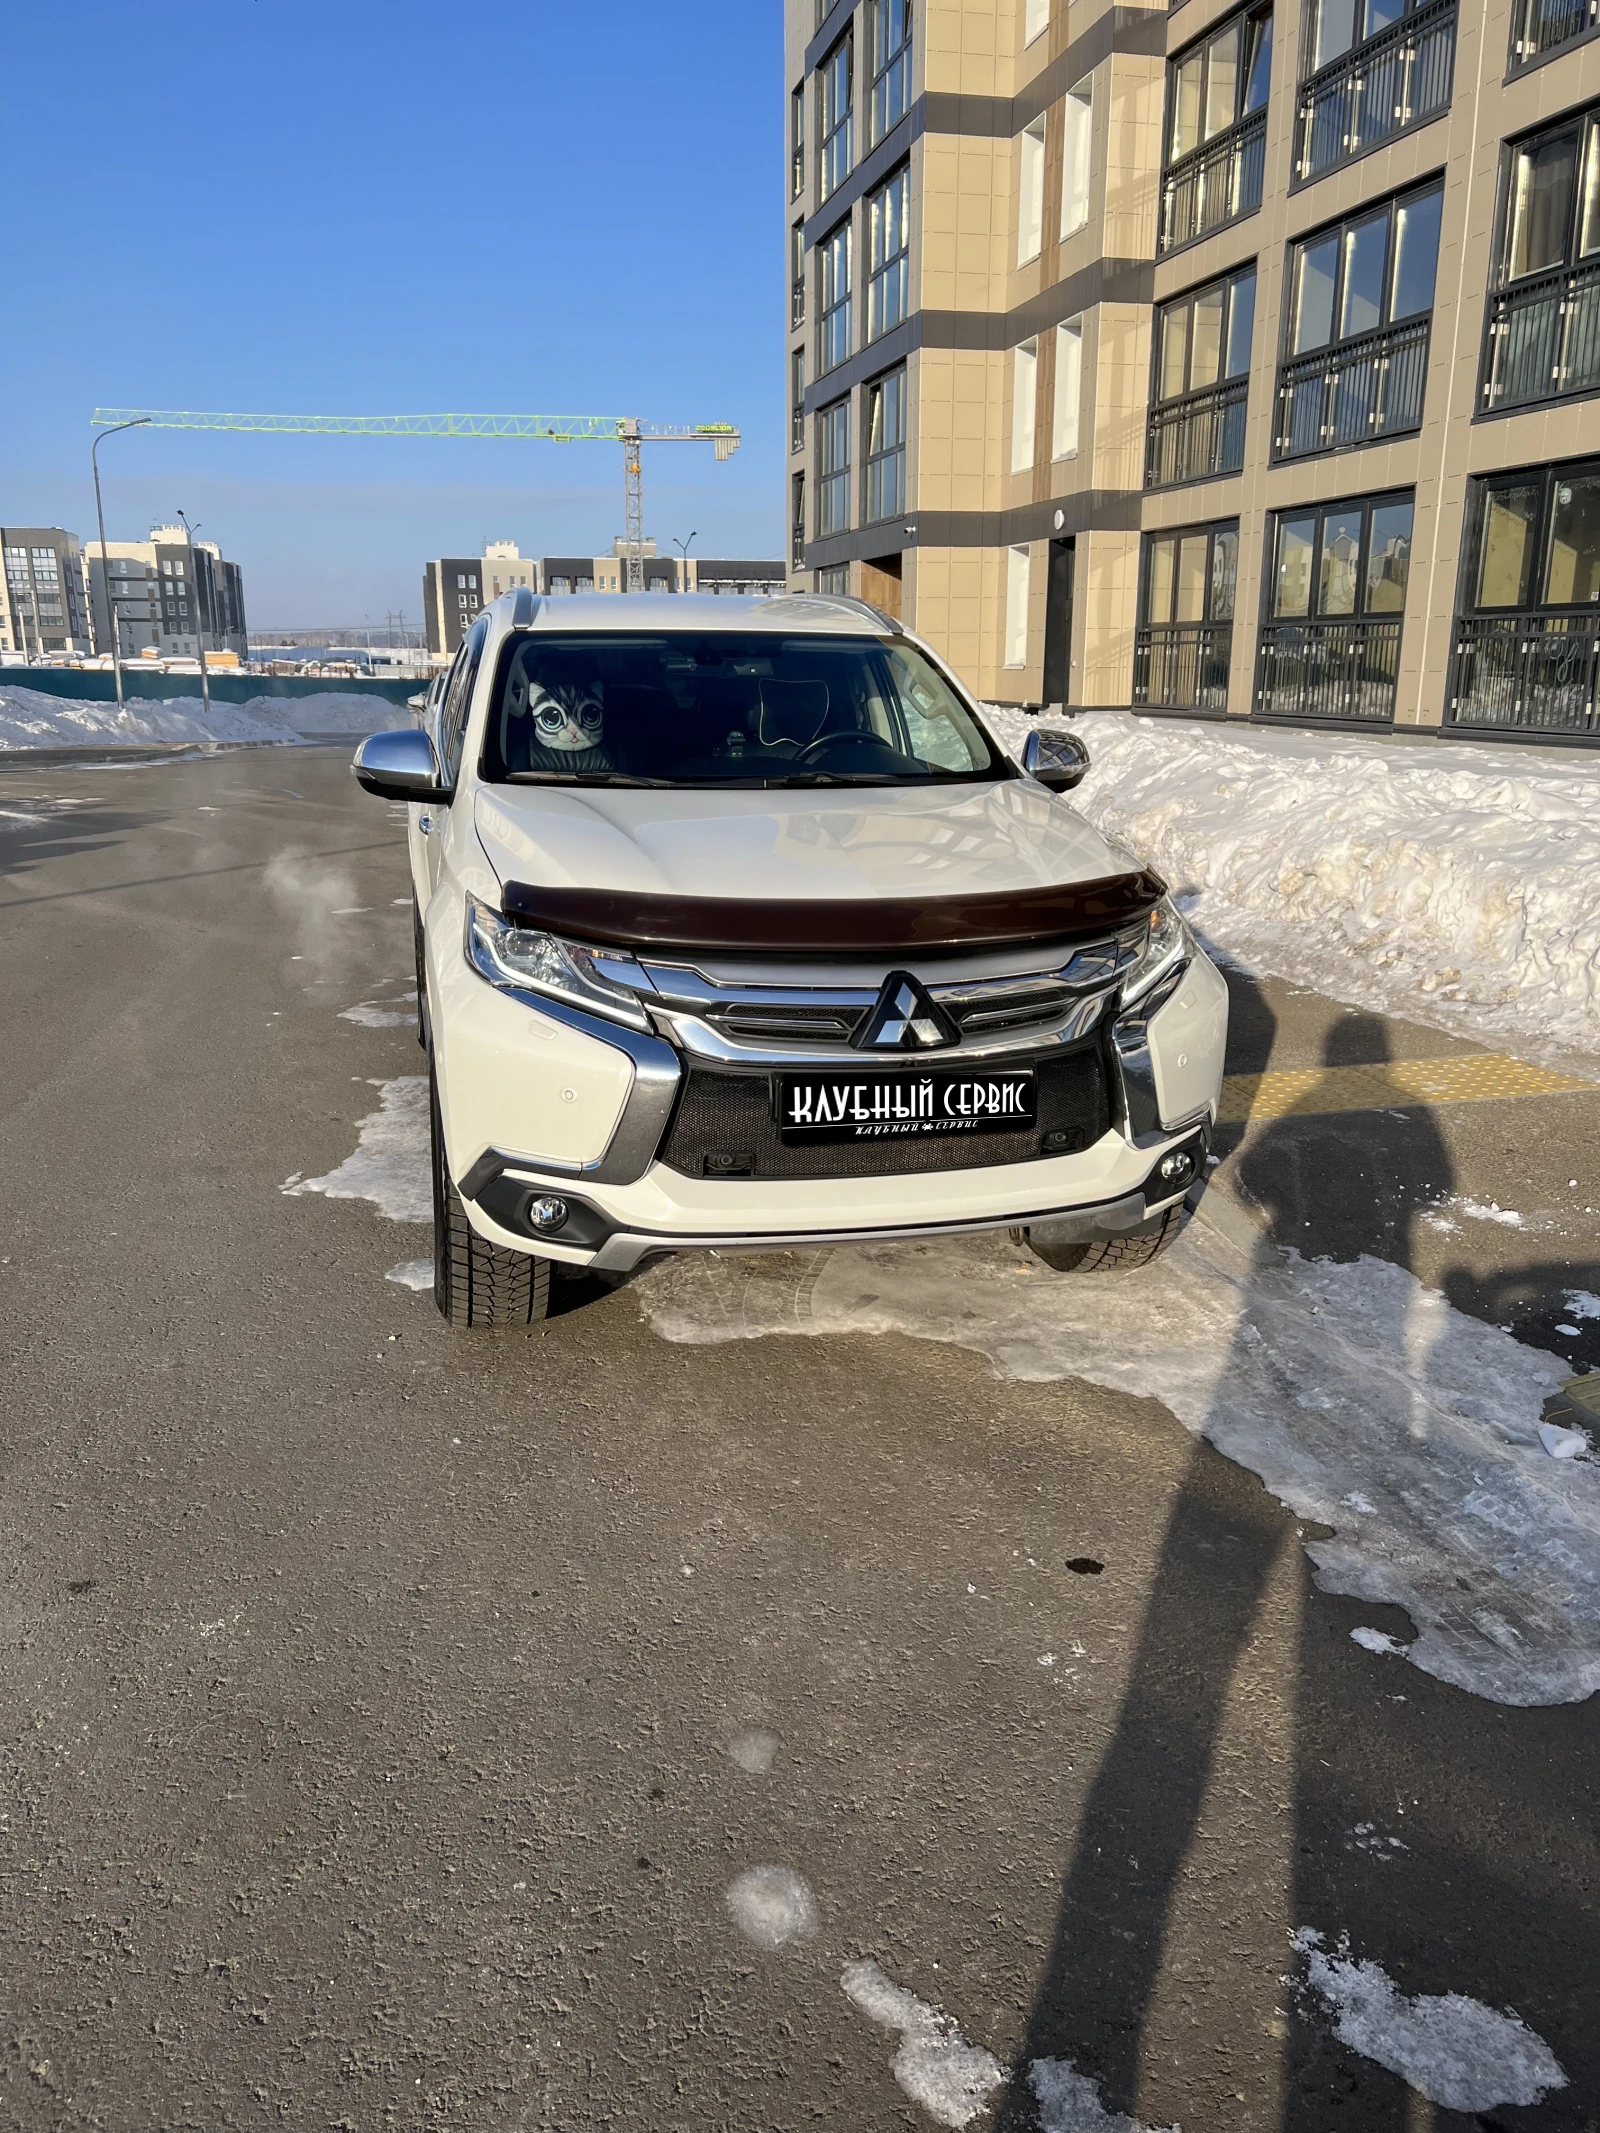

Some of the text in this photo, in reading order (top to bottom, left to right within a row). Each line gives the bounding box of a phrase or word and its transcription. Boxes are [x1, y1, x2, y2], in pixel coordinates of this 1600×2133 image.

[788, 1078, 1026, 1123] КЛУБНЫЙ СЕРВИС
[855, 1119, 979, 1135] КЛУБНЫЙ СЕРВИС
